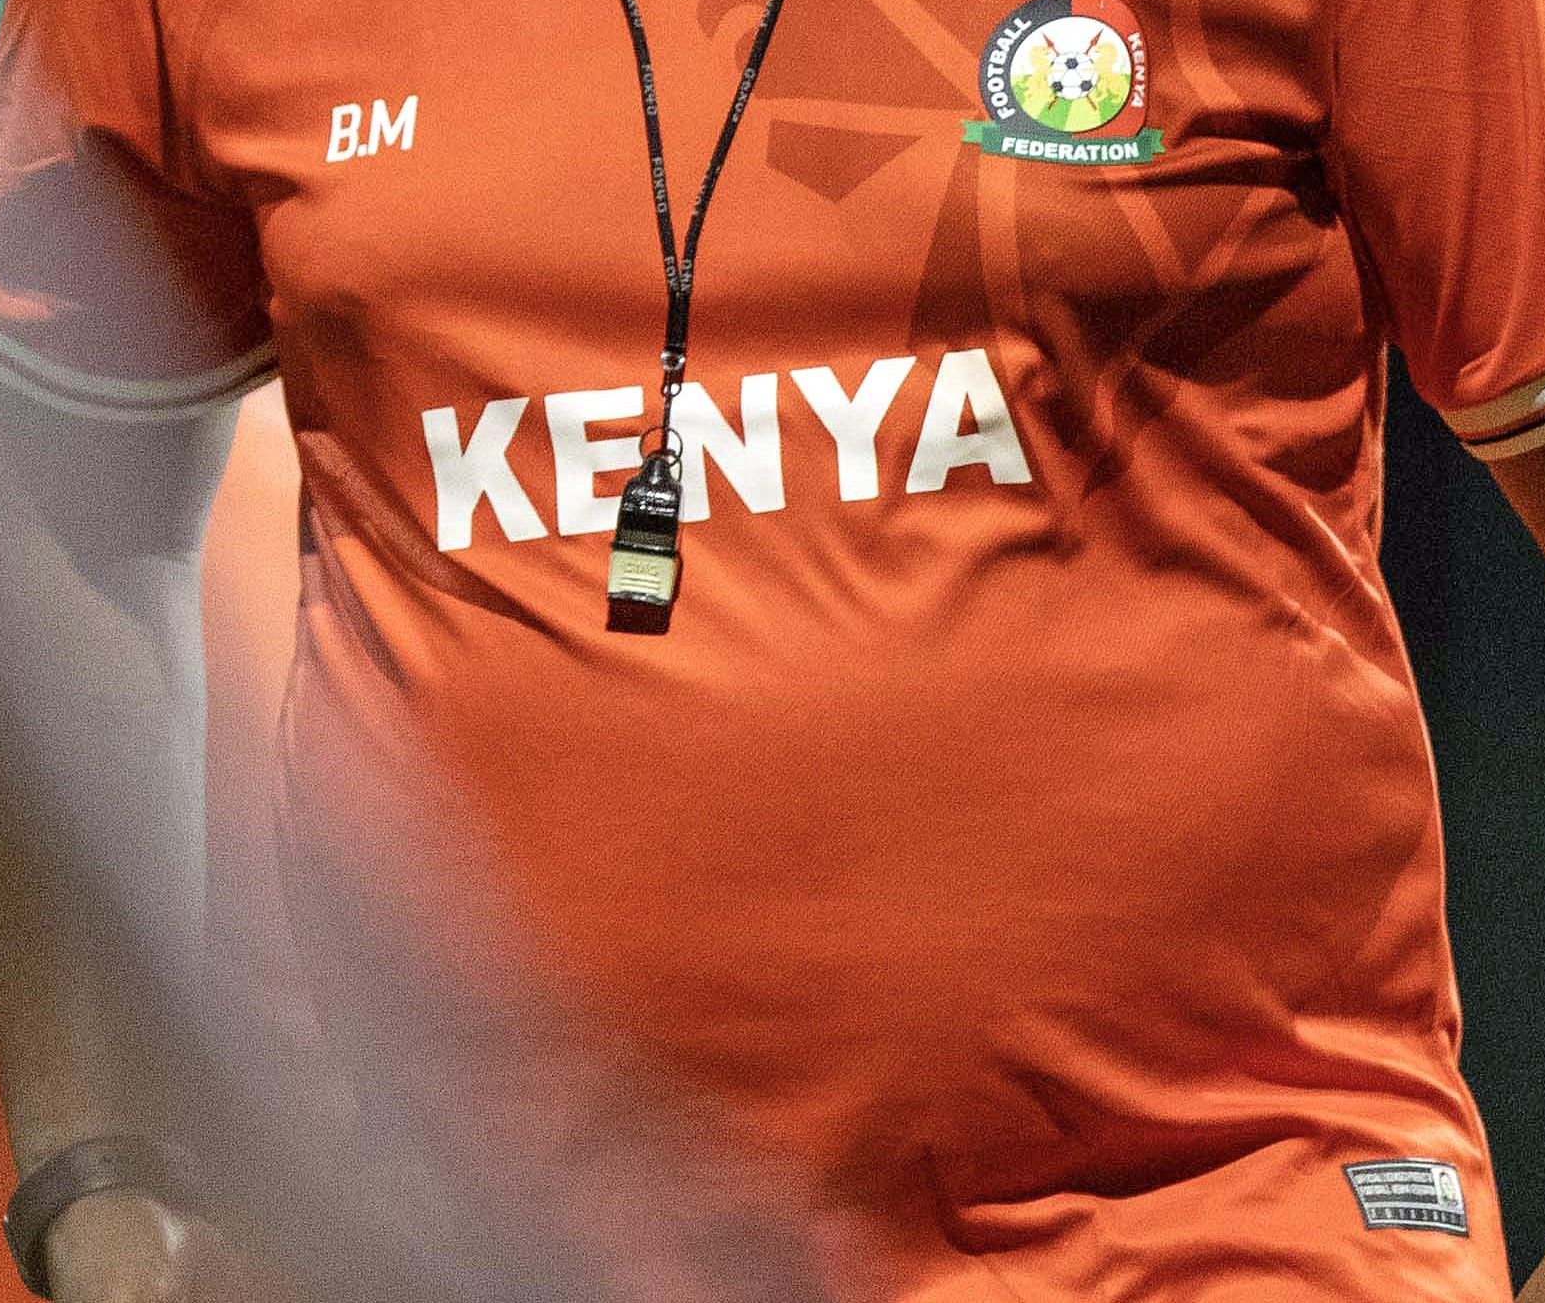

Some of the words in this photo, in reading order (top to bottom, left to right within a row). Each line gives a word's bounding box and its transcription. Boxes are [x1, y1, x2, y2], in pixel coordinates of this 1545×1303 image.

[641, 63, 659, 116] FOX40
[733, 67, 756, 122] FOX40
[987, 17, 1032, 120] FOOTBALL
[1127, 32, 1146, 108] KENYA
[324, 94, 420, 163] B.M
[1002, 136, 1140, 161] FEDERATION
[652, 156, 668, 213] FOX40
[421, 348, 1033, 552] KENYA
